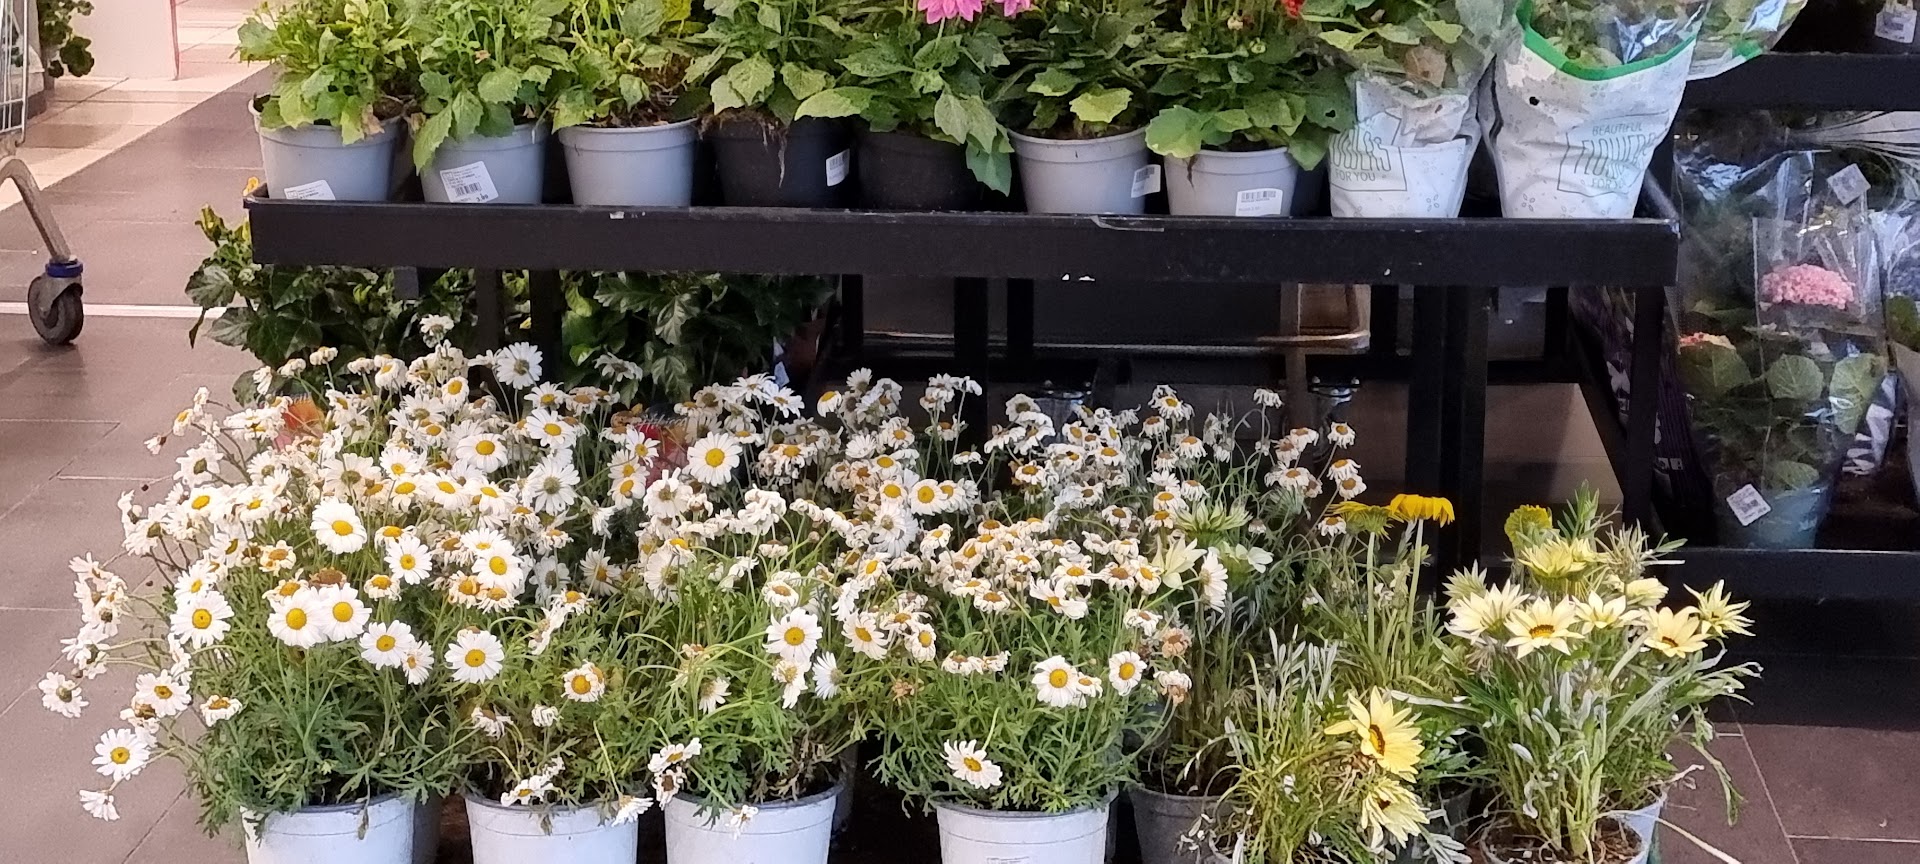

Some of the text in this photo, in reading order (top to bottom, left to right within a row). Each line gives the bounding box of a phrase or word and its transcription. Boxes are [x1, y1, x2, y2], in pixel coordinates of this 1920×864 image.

[1592, 122, 1642, 136] BEAUTIFUL
[1332, 127, 1392, 172] OWERS
[1335, 169, 1376, 182] FOR YOU
